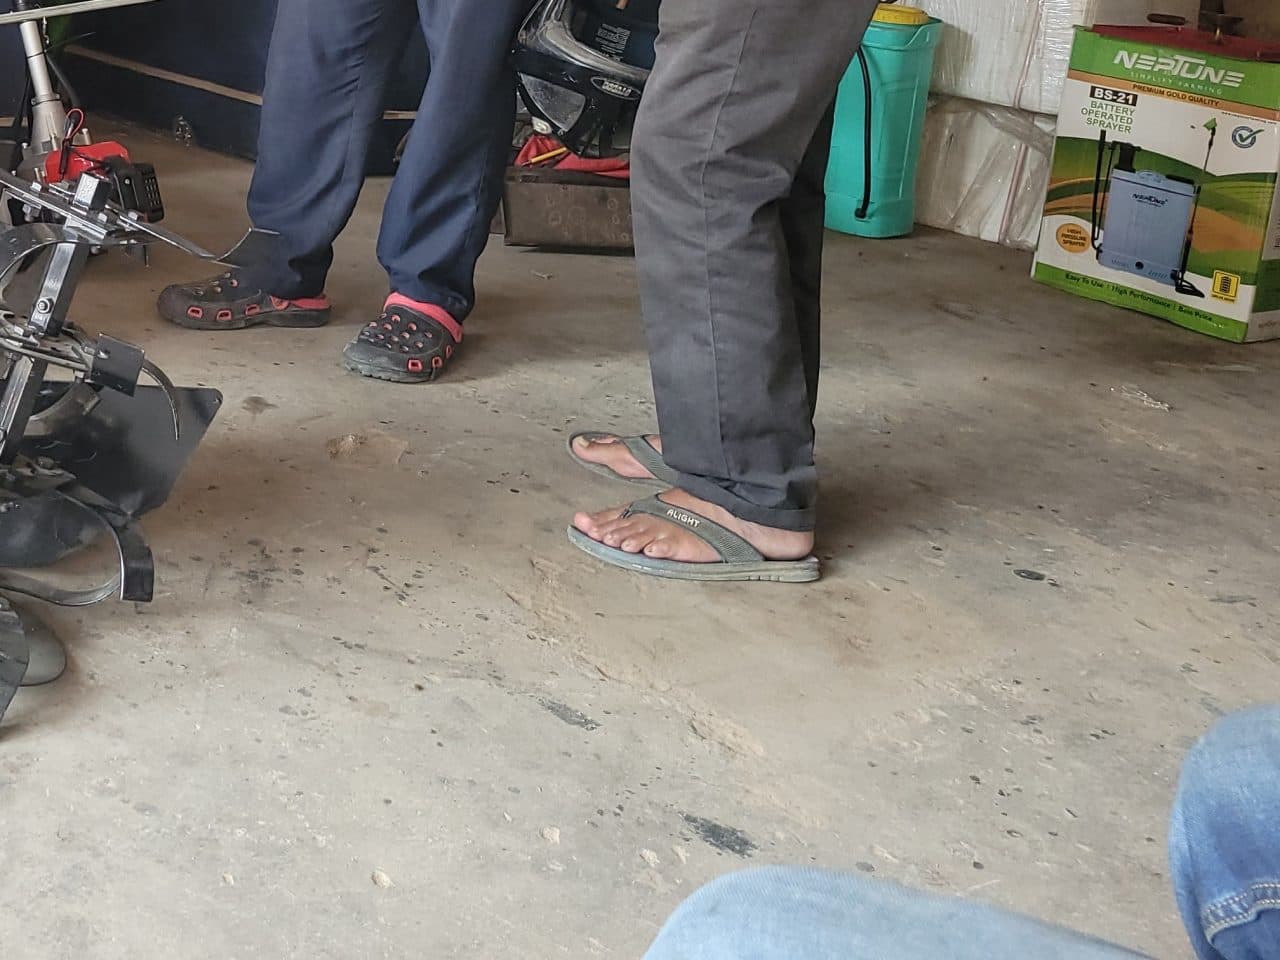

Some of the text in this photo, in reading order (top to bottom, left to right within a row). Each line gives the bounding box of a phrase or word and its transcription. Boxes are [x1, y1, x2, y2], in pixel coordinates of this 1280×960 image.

[1113, 50, 1245, 88] NEPTUNE
[1130, 71, 1223, 96] SIMPLIFY FARMING
[1093, 87, 1134, 105] BS-21
[1132, 83, 1220, 108] PREMIUM GOLD QUALITY
[1080, 107, 1134, 125] OPERATED
[1090, 100, 1136, 116] BATTERY
[1086, 117, 1132, 134] SPRAYER
[666, 508, 700, 528] ALIGHT
